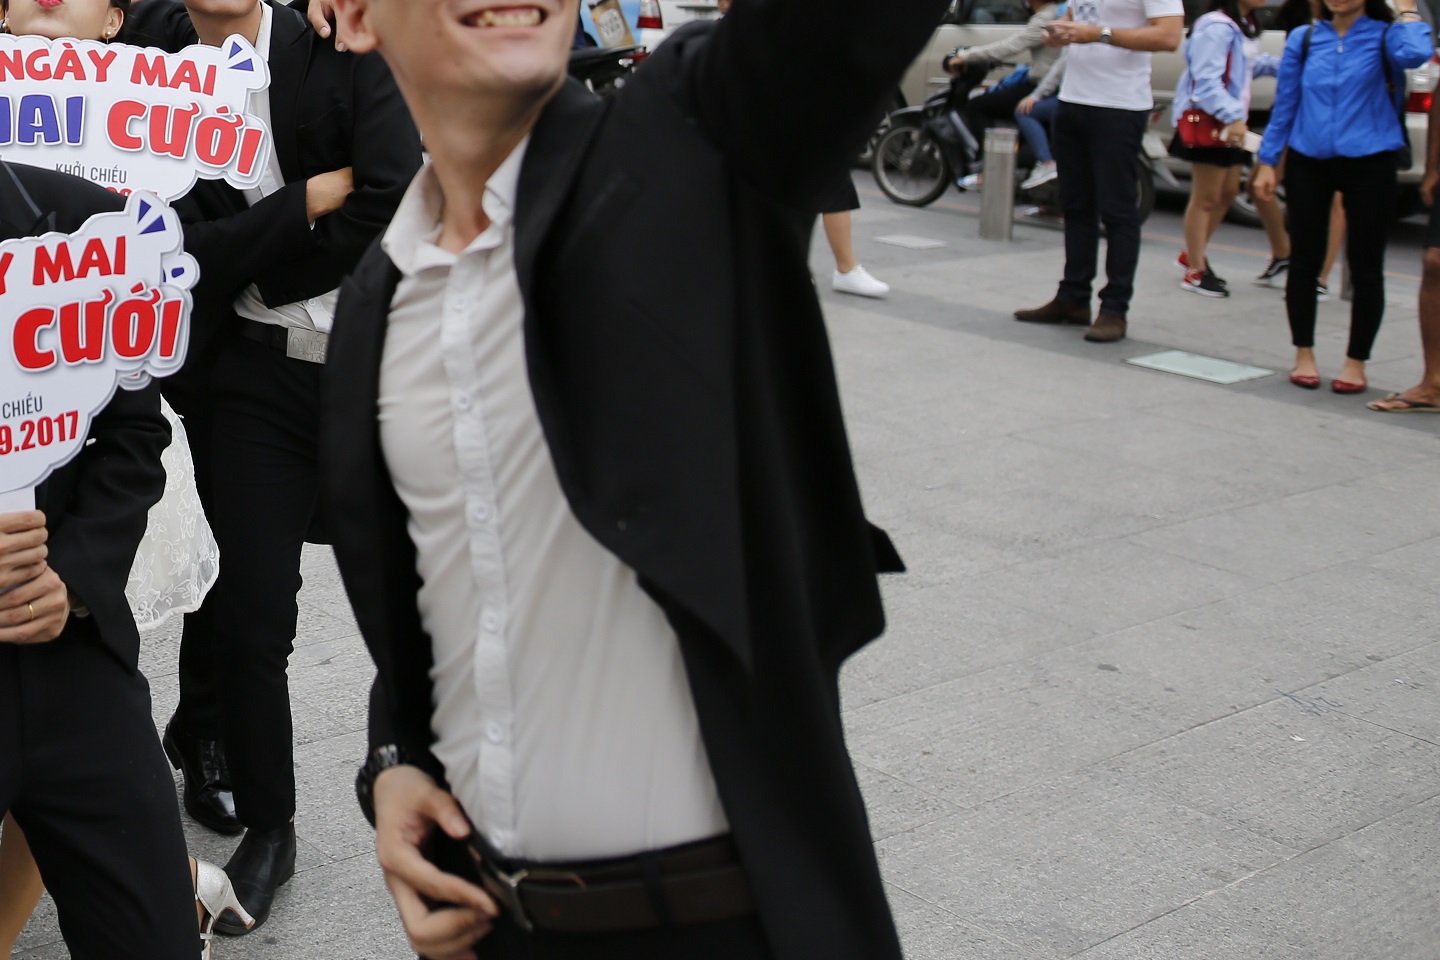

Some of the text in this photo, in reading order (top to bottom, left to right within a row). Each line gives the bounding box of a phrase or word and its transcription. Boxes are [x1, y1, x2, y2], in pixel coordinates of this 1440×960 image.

[130, 53, 216, 96] MAI
[107, 100, 263, 175] CƯỚI
[90, 165, 127, 183] CHIẾU
[32, 236, 126, 286] MAI
[13, 282, 182, 369] CƯỚI
[2, 392, 43, 420] CHIẾU
